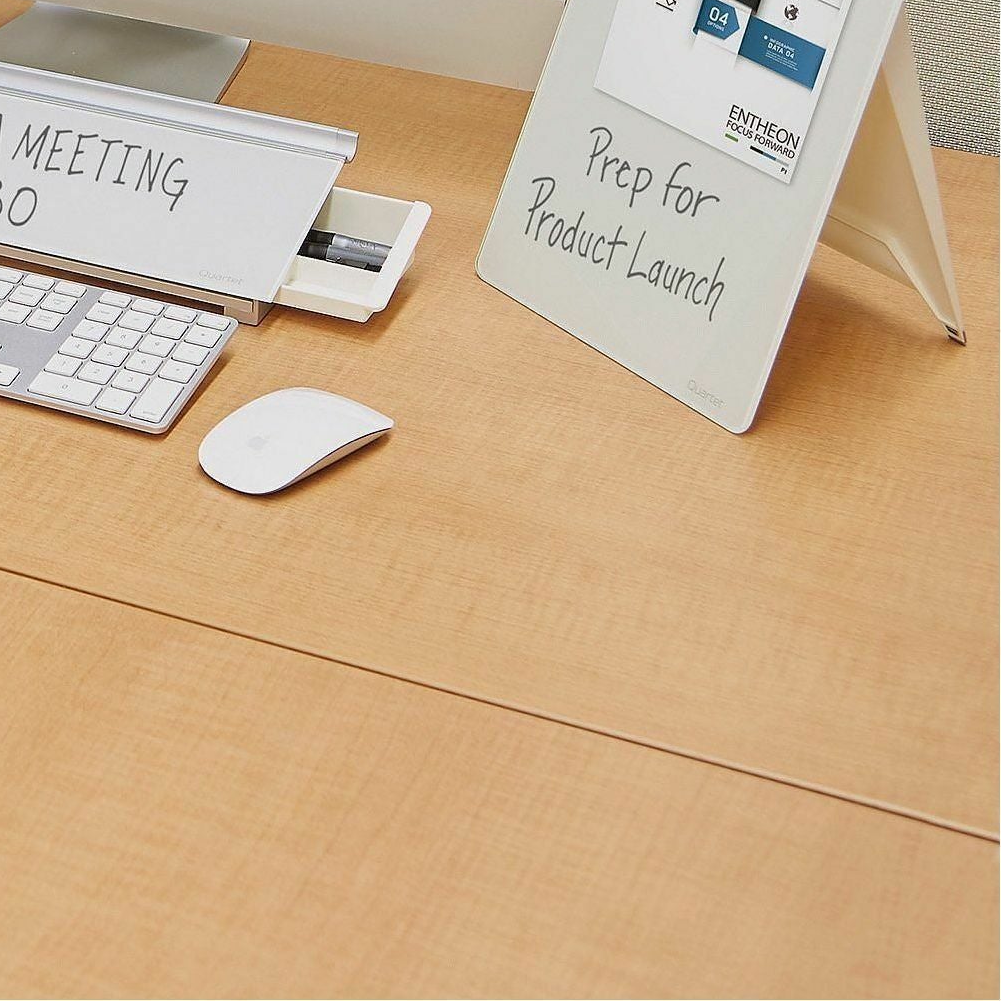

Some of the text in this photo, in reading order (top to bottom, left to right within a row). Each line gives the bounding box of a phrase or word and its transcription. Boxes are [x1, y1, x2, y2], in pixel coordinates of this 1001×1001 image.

[709, 7, 729, 26] 04
[767, 42, 795, 59] DATA 04
[726, 120, 796, 159] FOCUS FORWARD
[729, 104, 800, 150] ENTHEON
[12, 124, 189, 212] MEETING
[586, 127, 720, 217] Prep for
[525, 177, 725, 322] Product Launch
